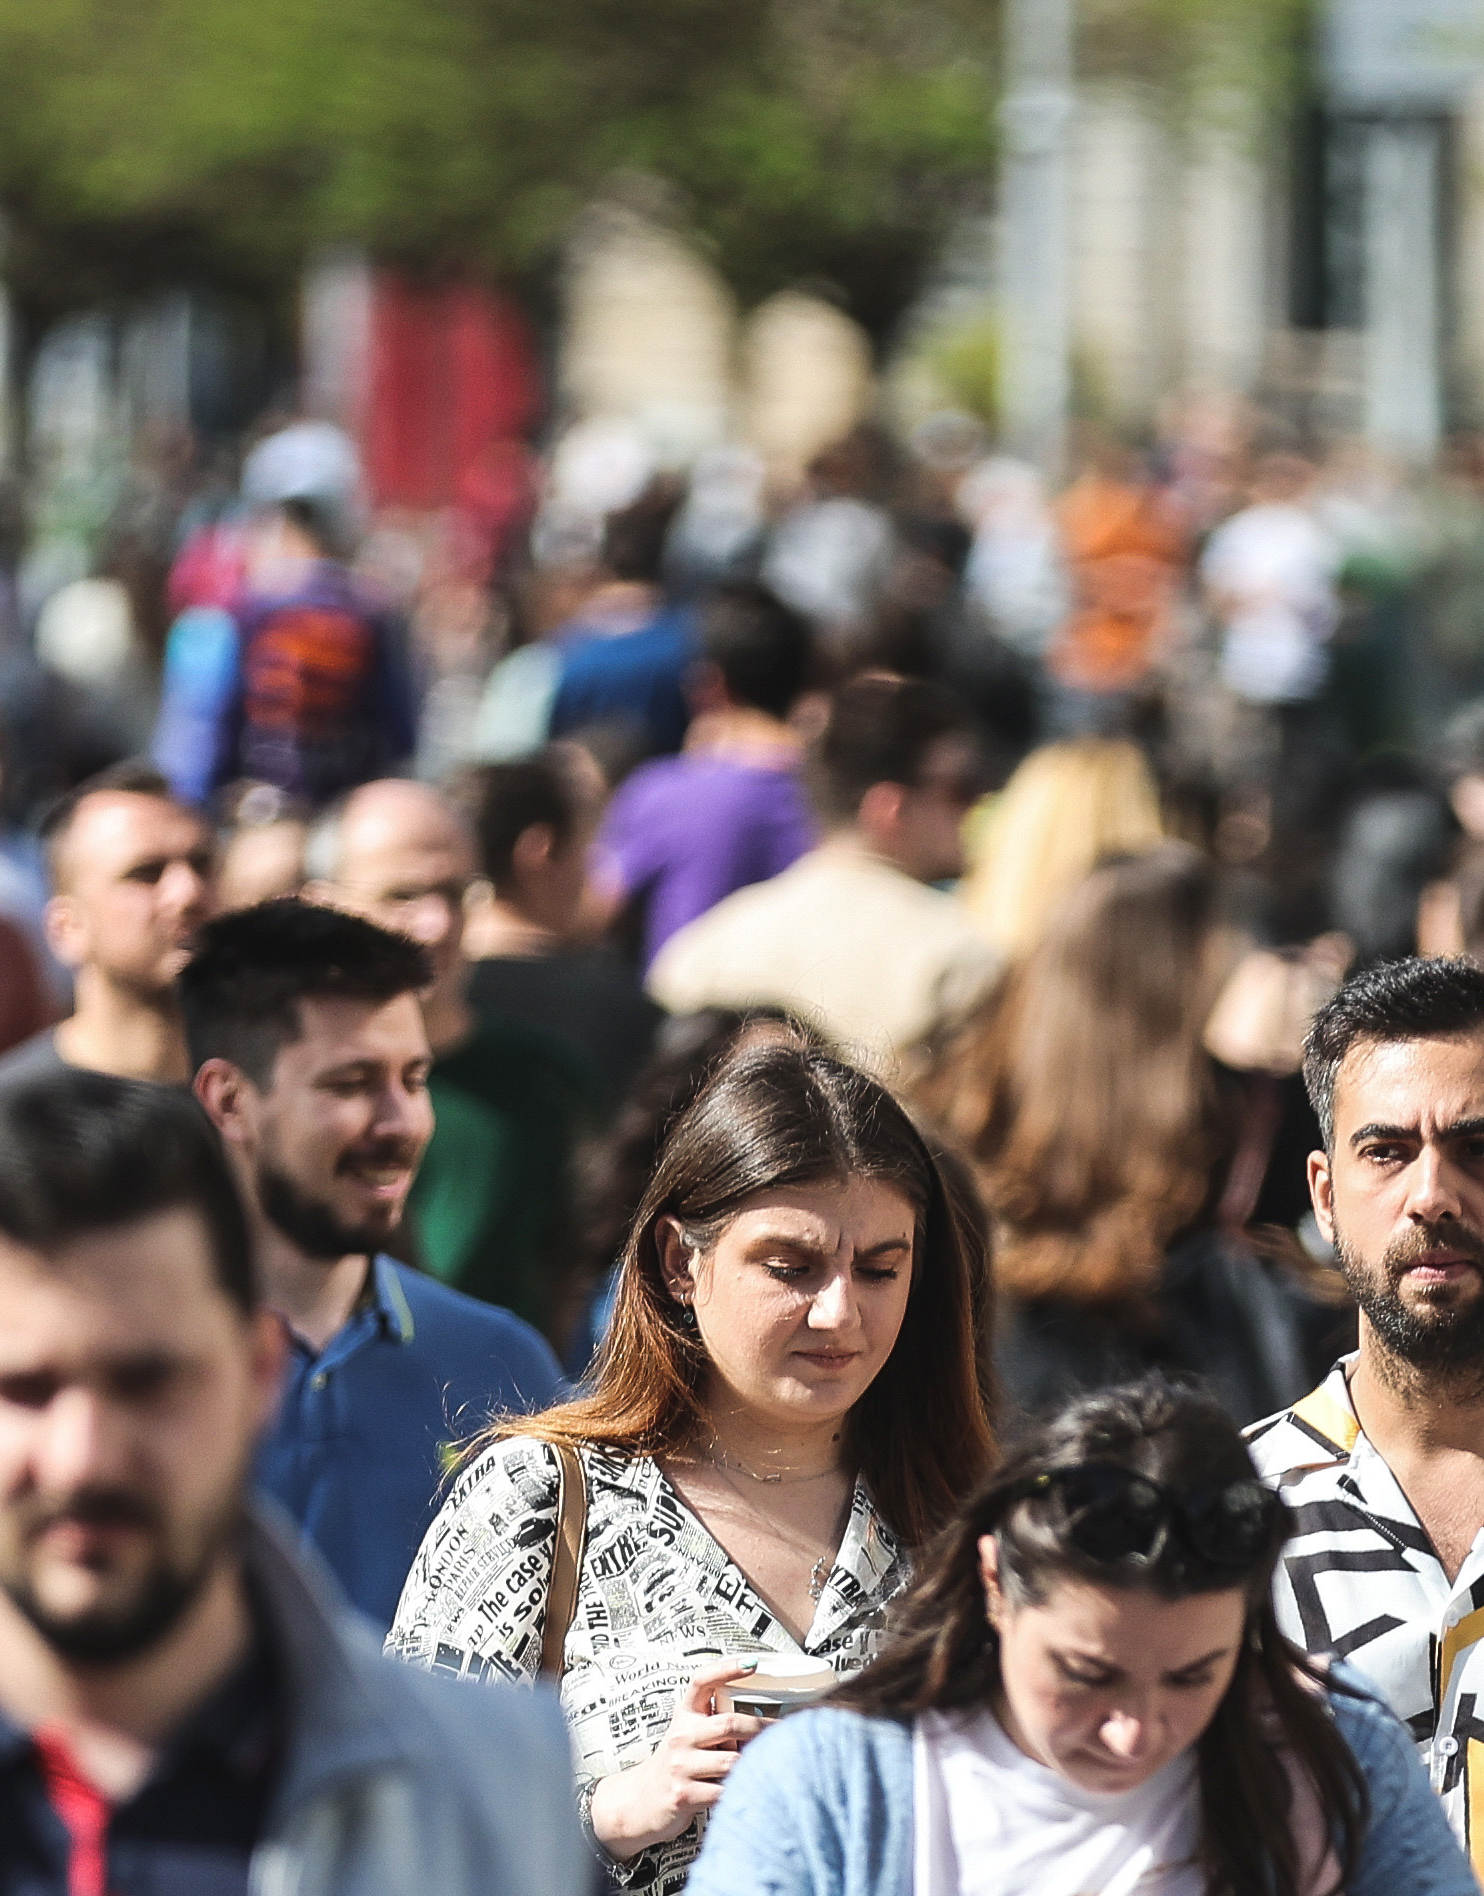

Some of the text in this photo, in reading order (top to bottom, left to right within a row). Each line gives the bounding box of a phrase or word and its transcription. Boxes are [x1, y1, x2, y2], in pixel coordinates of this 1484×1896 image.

[442, 1548, 476, 1592] PARIS
[478, 1590, 509, 1623] The
[506, 1554, 542, 1595] case
[495, 1621, 514, 1638] is
[586, 1602, 608, 1631] THE
[615, 1662, 660, 1685] World
